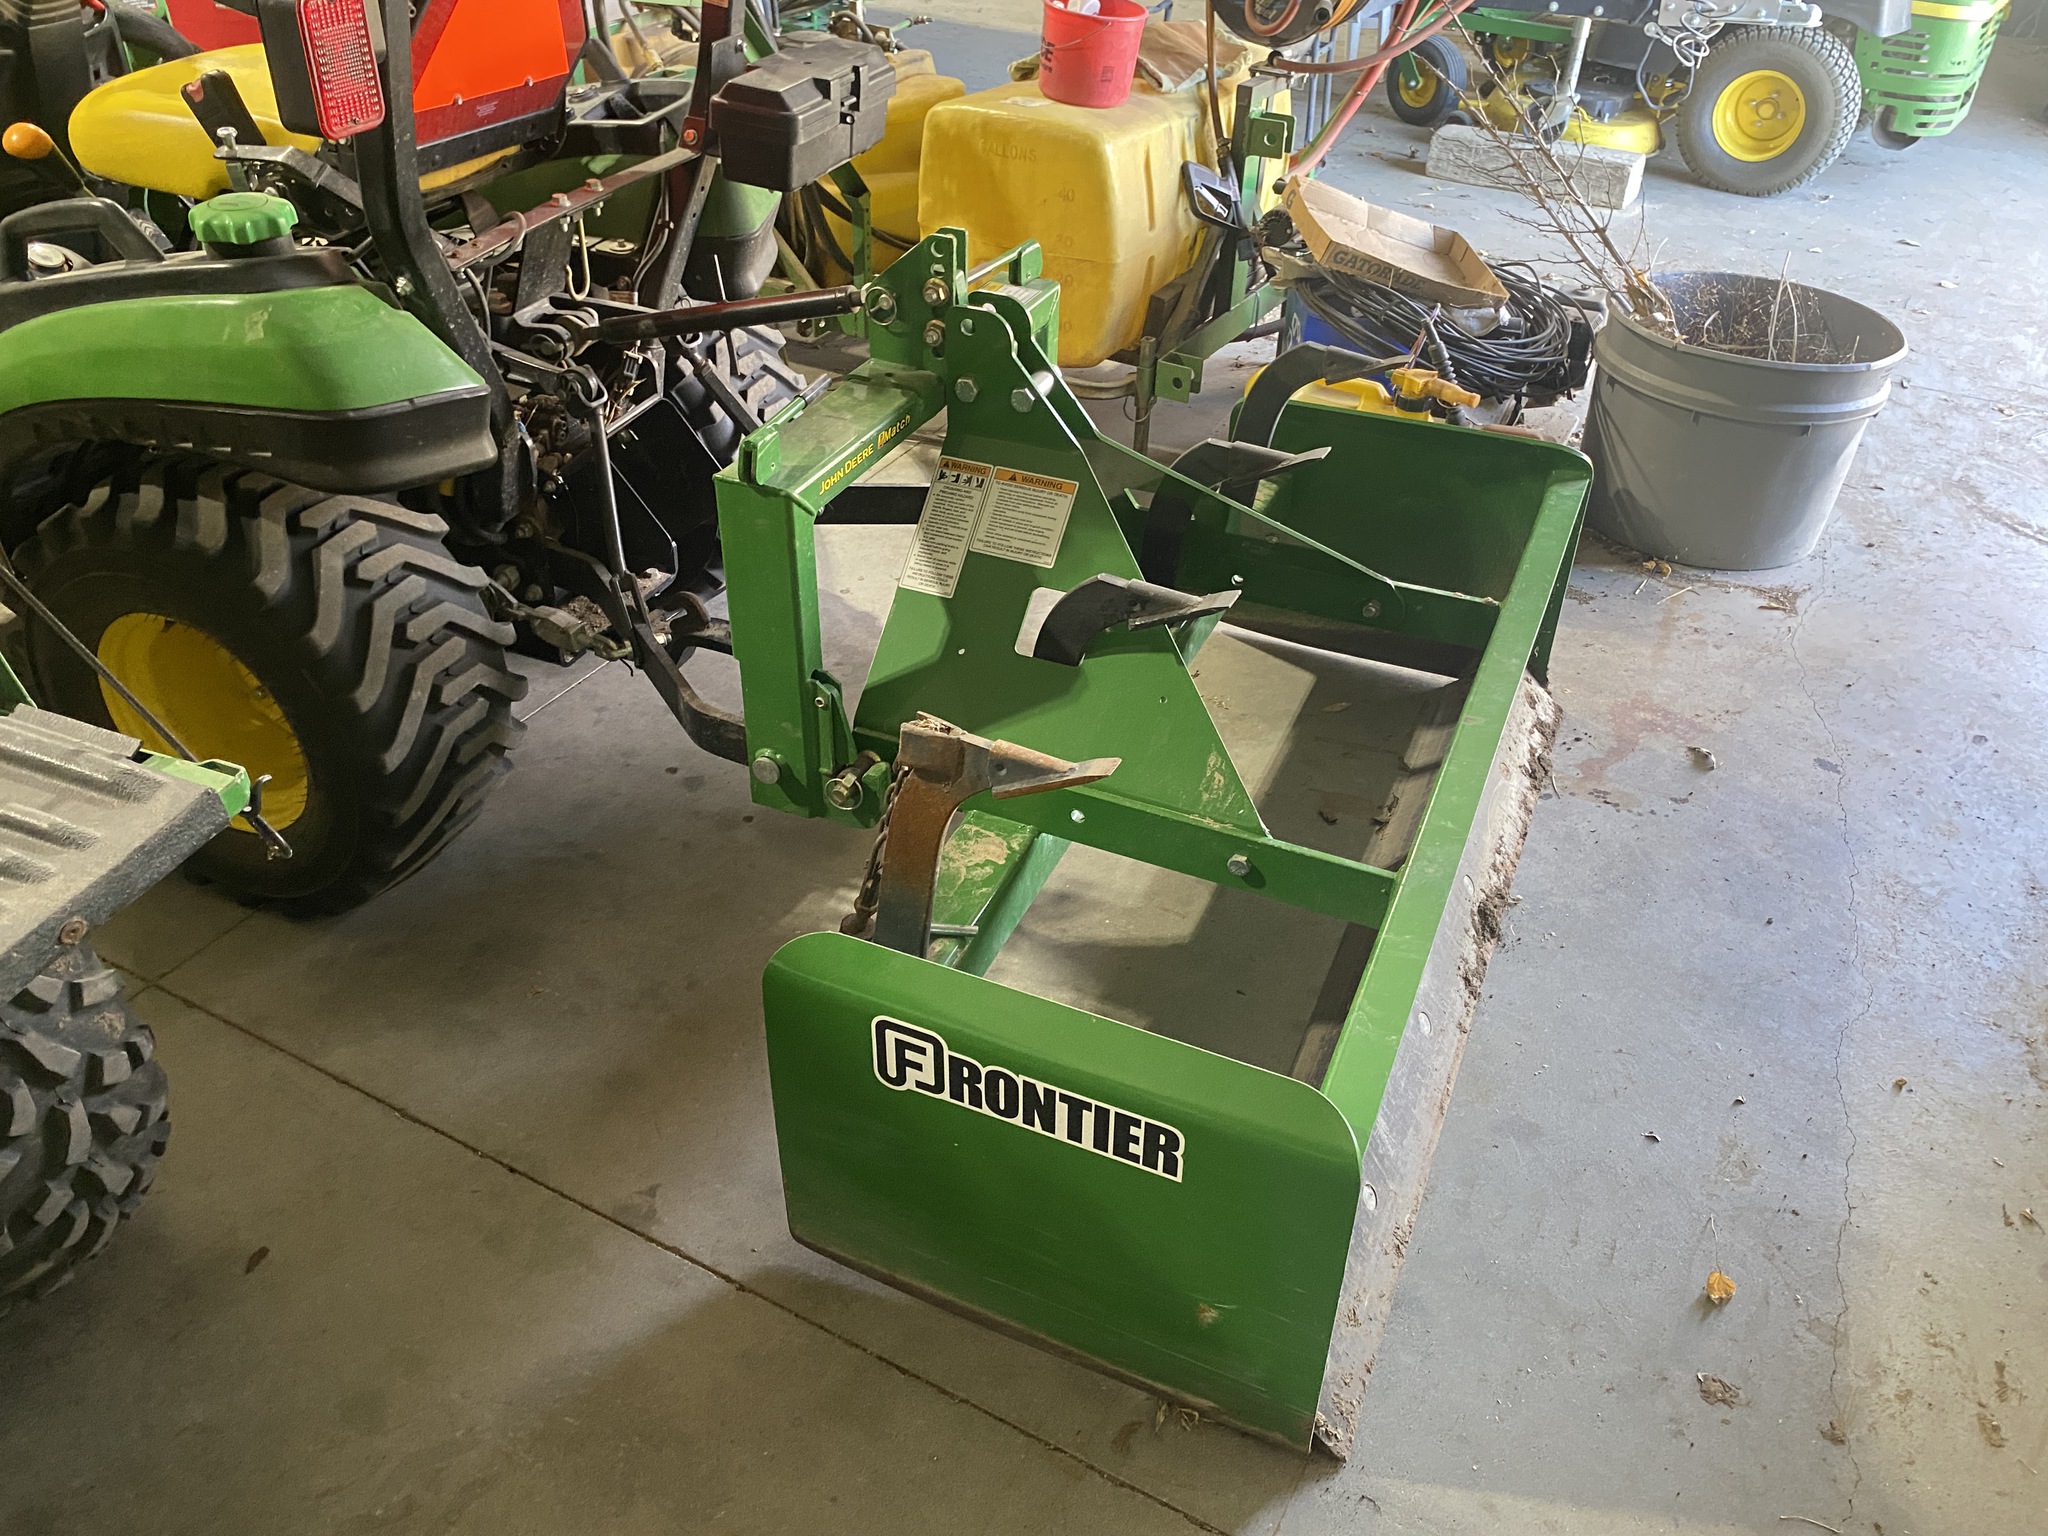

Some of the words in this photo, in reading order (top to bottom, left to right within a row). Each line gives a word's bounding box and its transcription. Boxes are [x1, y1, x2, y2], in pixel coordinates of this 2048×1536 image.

[979, 139, 1038, 163] GALLONS
[1058, 187, 1075, 203] 40
[819, 467, 844, 495] JOHN
[844, 443, 875, 474] DEERE
[951, 461, 987, 475] WARNING
[1021, 475, 1063, 490] WARNING
[873, 1018, 1181, 1179] FRONTIER
